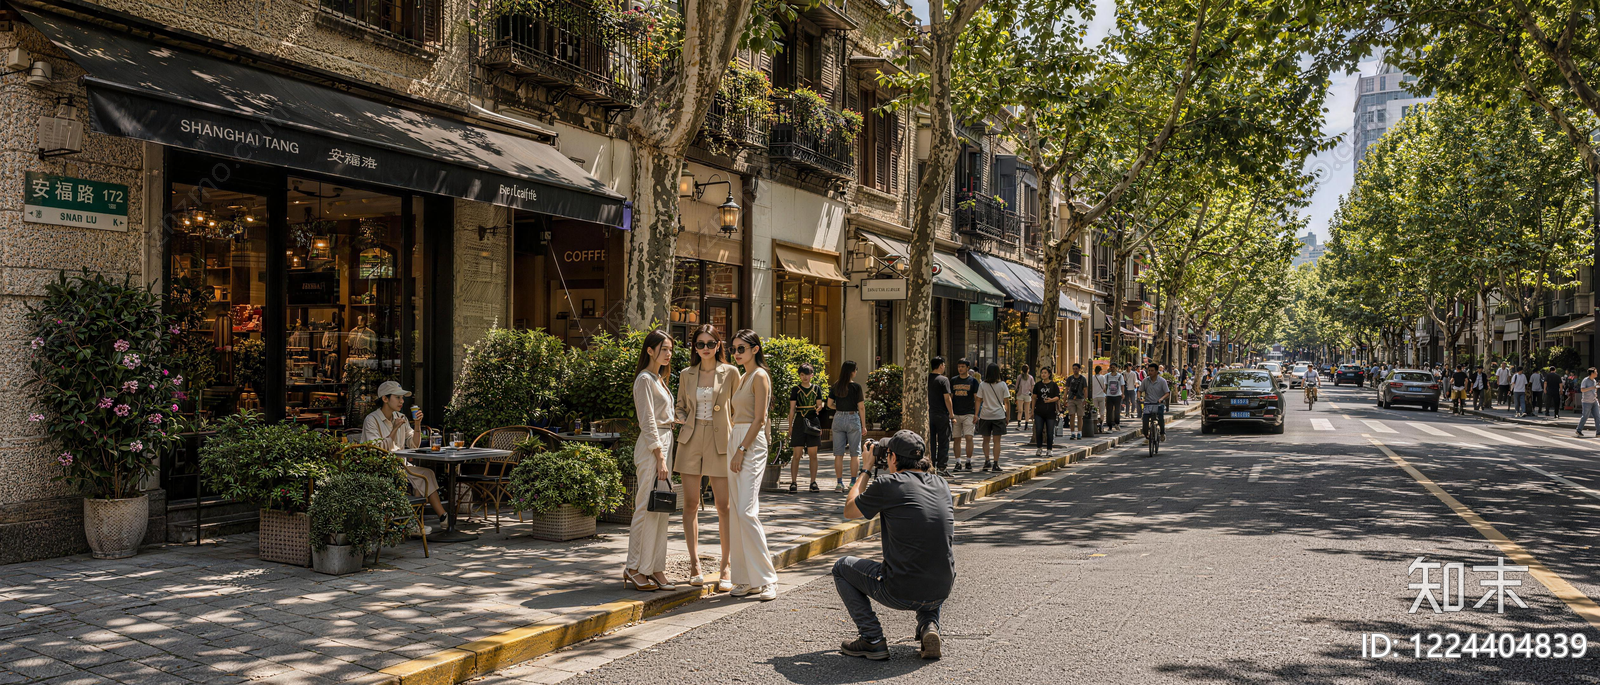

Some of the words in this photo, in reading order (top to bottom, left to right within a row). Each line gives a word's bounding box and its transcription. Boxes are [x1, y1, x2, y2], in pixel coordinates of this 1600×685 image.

[180, 119, 259, 146] SHANGHAI
[263, 135, 299, 154] TANG
[32, 179, 94, 204] 安福路
[102, 189, 124, 203] 172
